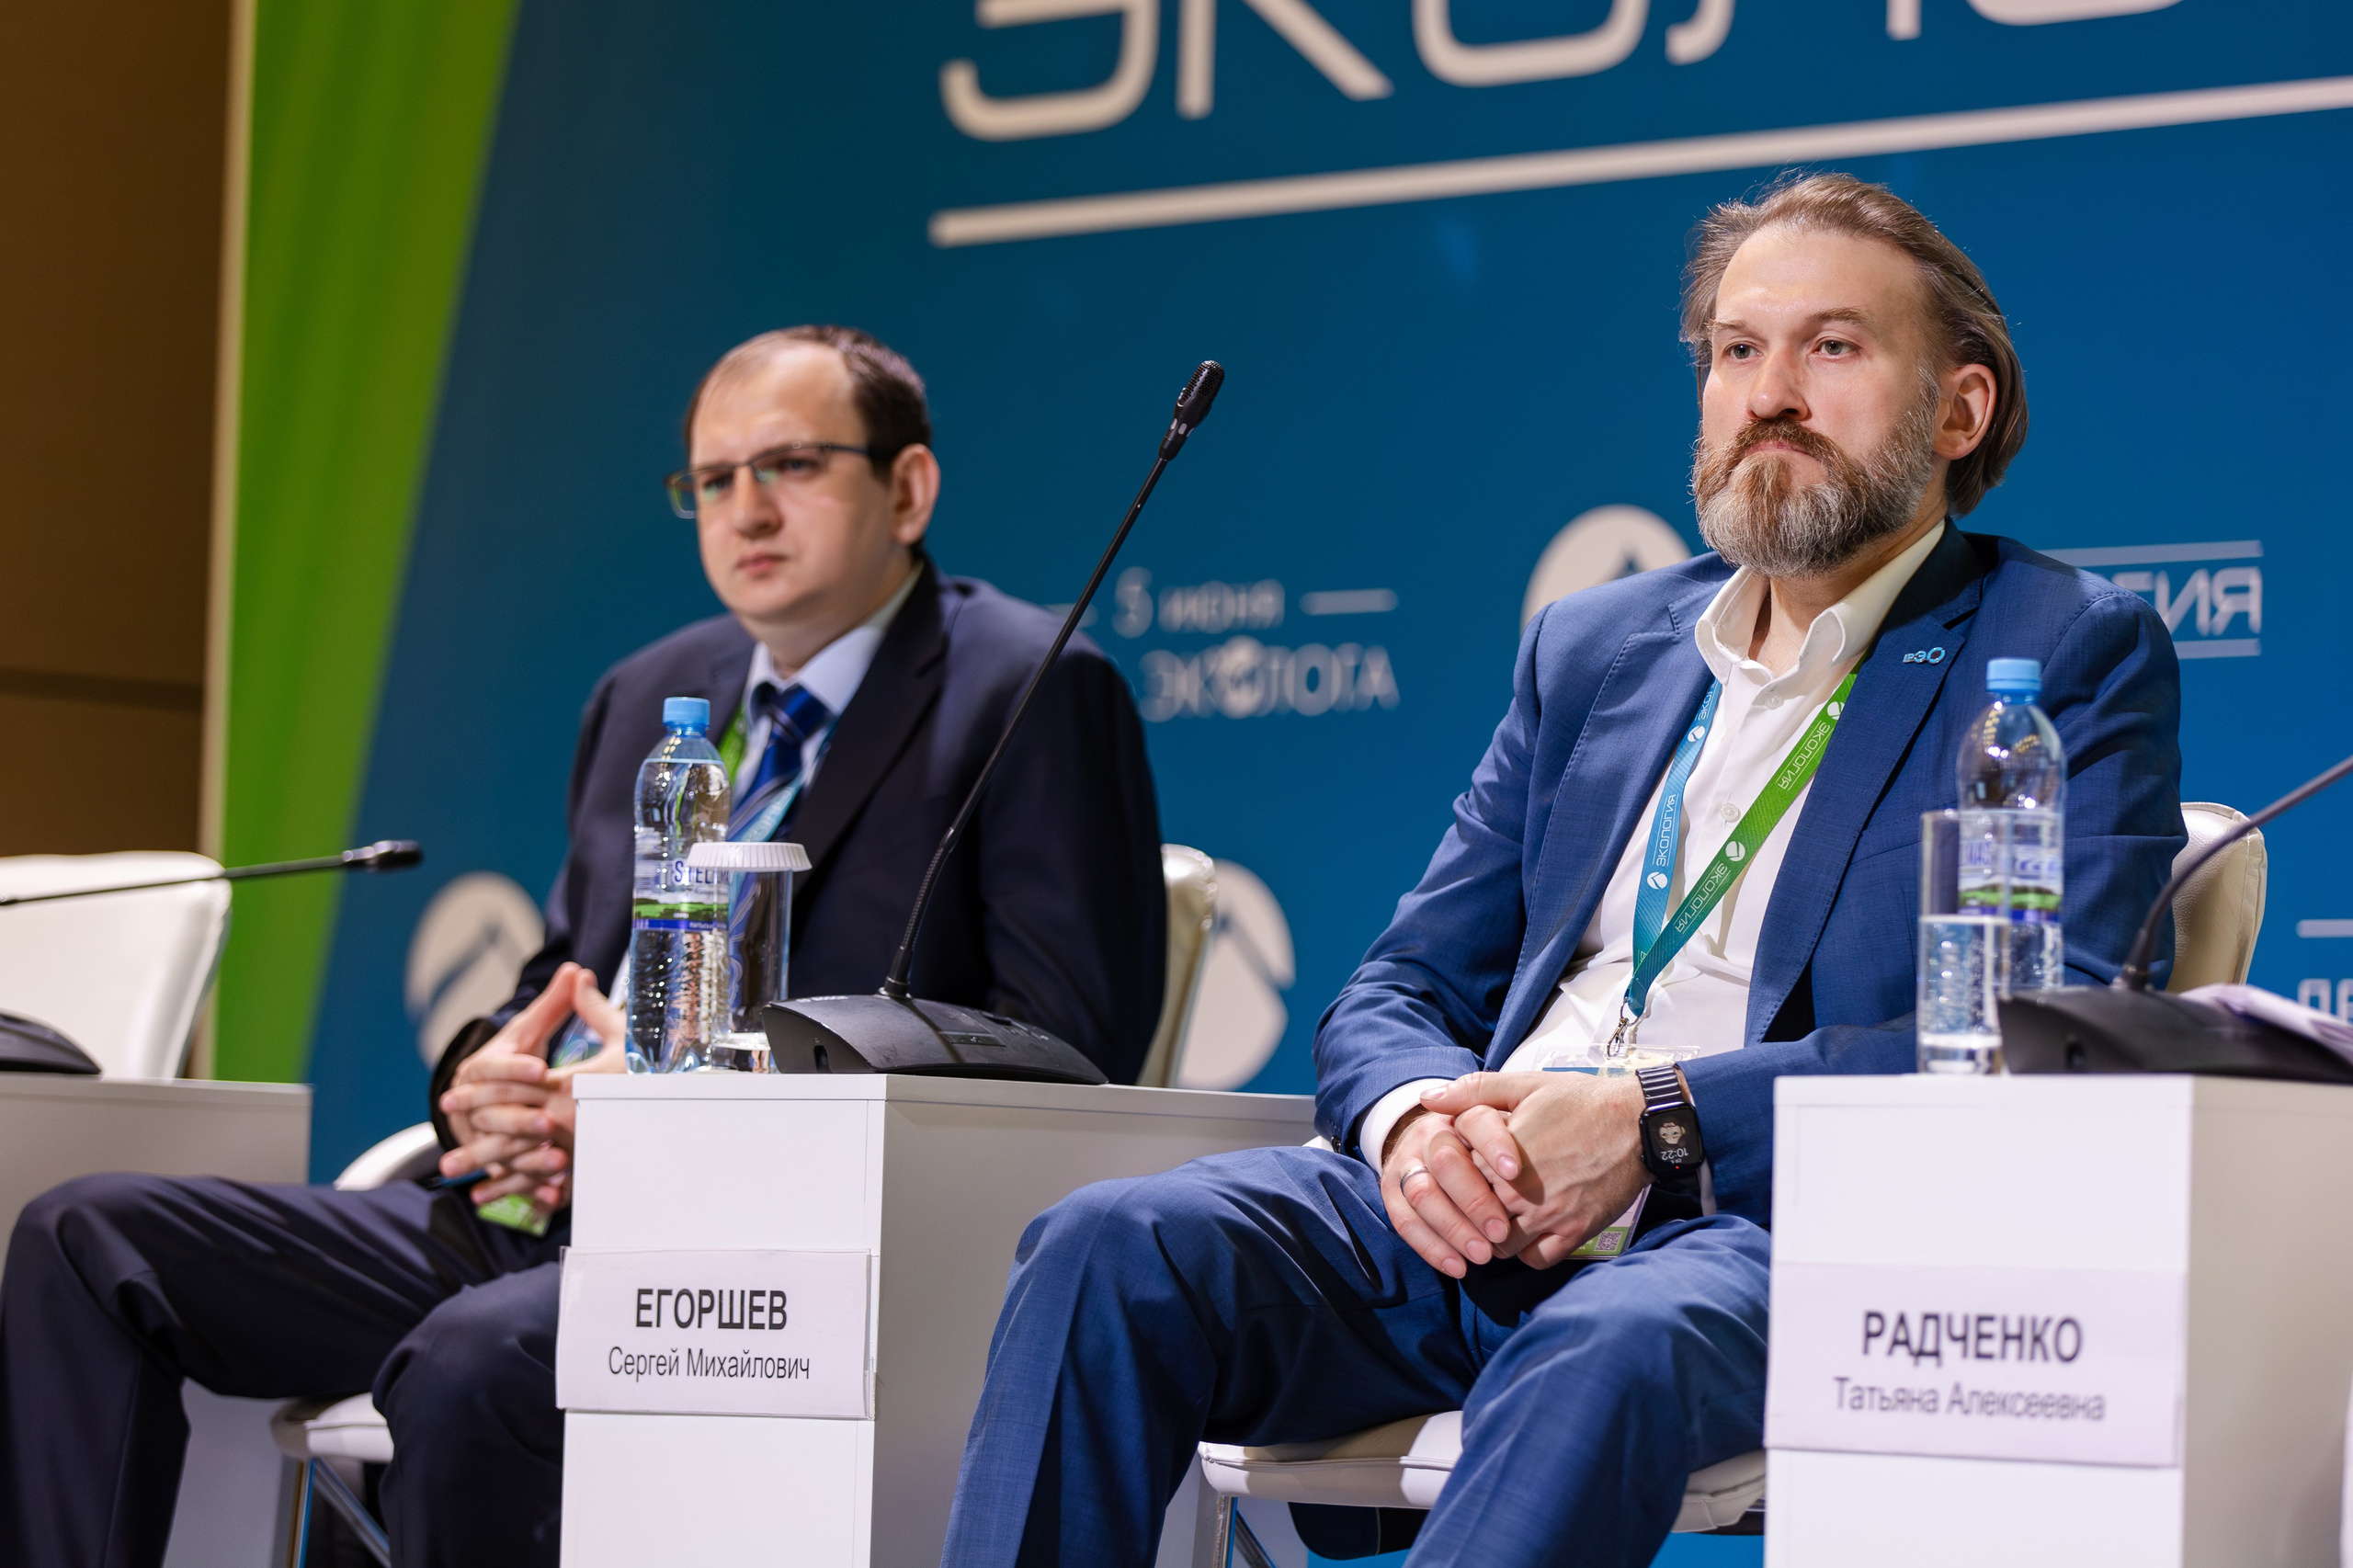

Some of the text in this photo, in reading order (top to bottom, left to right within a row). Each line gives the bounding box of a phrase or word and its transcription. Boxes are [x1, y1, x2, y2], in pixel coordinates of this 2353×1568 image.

[1778, 721, 1831, 790] ЭКОЛОГИЯ
[1656, 795, 1677, 867] ЭКОЛОГИЯ
[1674, 862, 1729, 934] ЭКОЛОГИЯ
[1662, 1148, 1688, 1161] 10:22
[636, 1288, 788, 1330] ЕГОРШЕВ
[608, 1346, 811, 1382] Сергей Михайлович
[1862, 1310, 2084, 1368] РАДЧЕНКО
[1834, 1376, 2107, 1422] Татьяна Алексеевна
